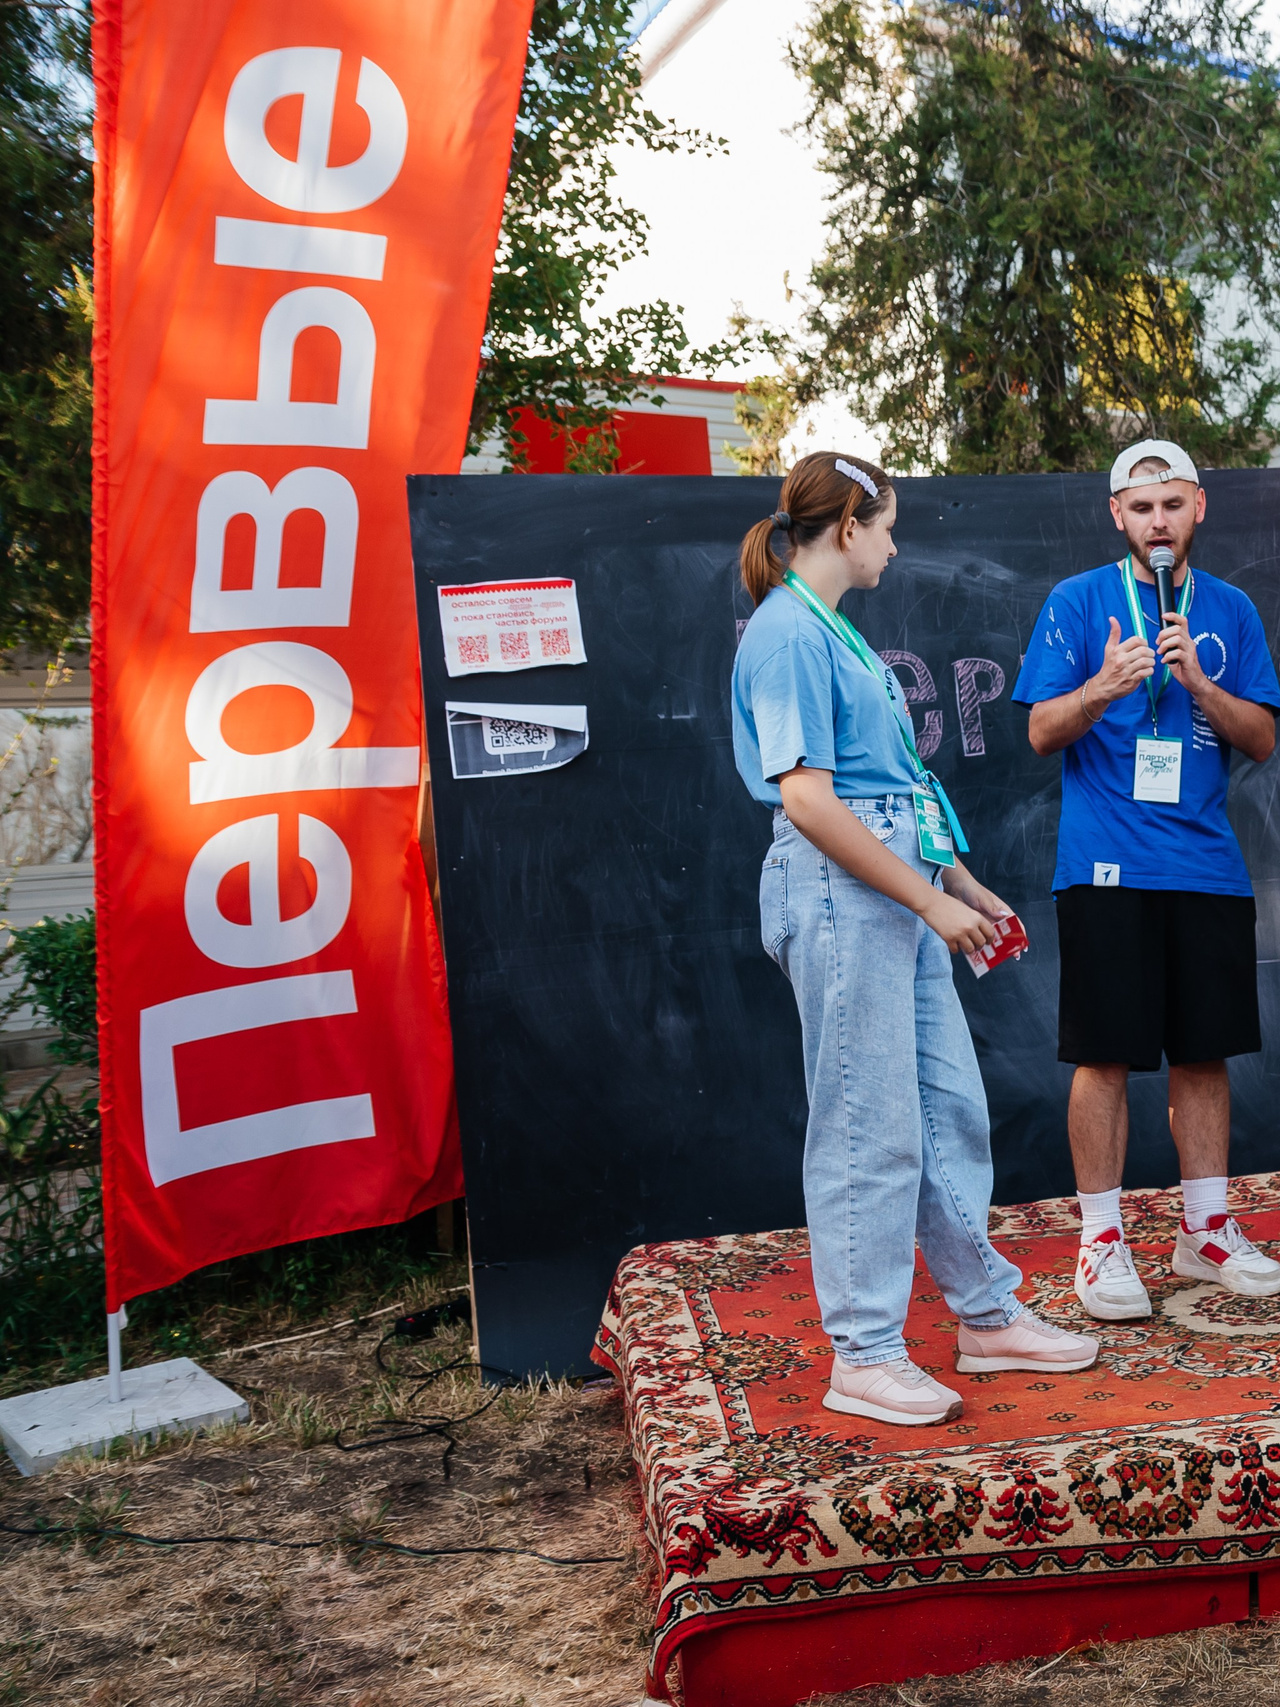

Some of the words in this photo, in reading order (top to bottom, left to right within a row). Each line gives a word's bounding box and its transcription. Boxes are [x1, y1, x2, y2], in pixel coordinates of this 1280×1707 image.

[451, 598, 496, 609] осталось
[498, 596, 533, 605] совсем
[139, 45, 420, 1188] Первые
[461, 613, 484, 622] пока
[486, 610, 535, 620] становись
[495, 618, 529, 627] частью
[530, 615, 567, 626] форума
